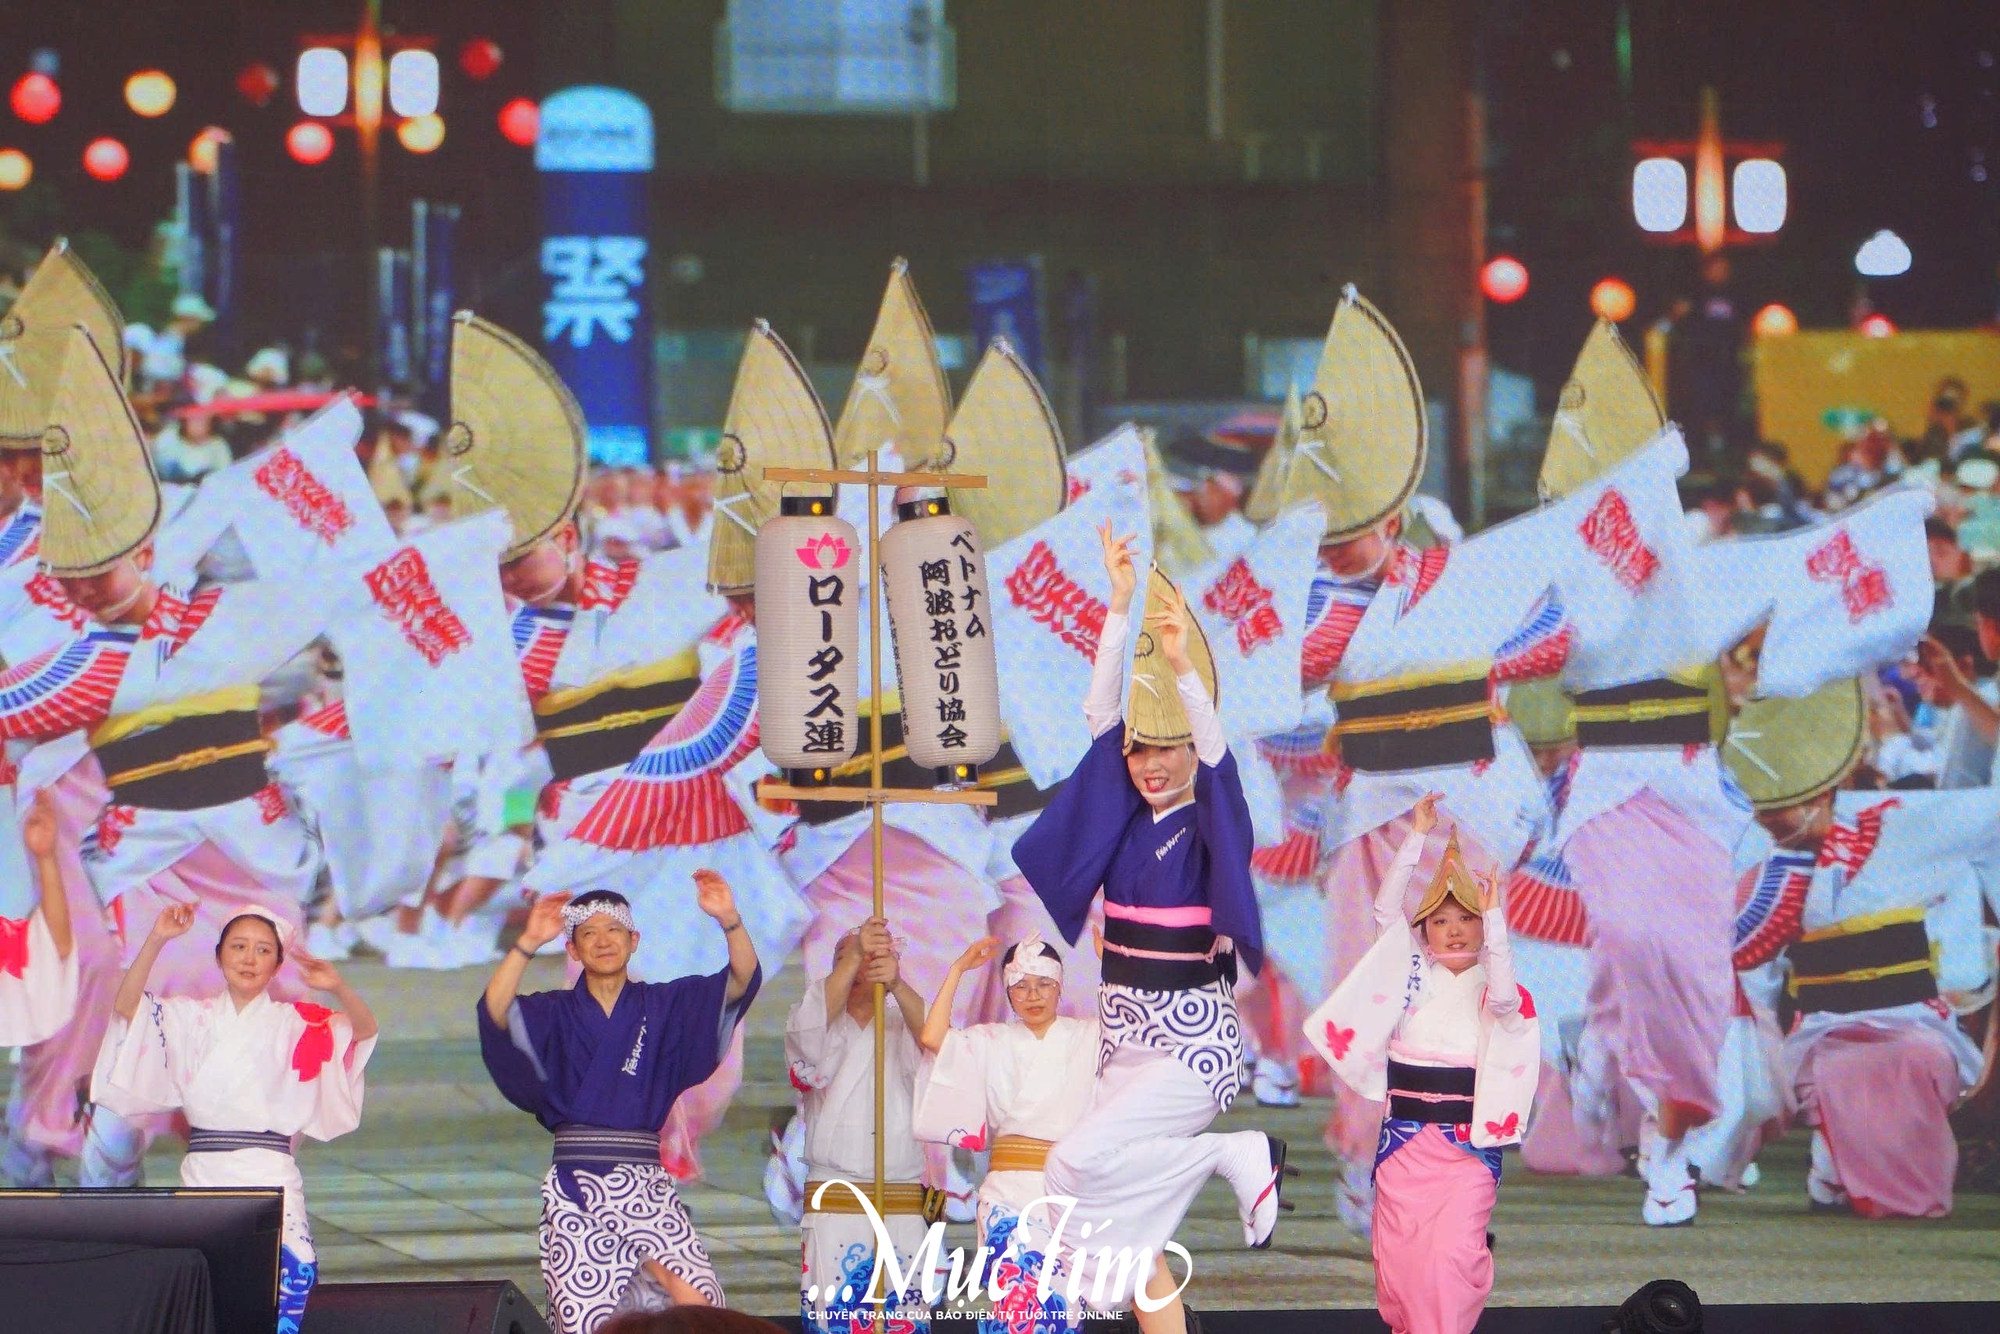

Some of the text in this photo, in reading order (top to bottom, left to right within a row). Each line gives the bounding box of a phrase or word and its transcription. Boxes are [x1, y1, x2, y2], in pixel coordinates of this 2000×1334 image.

[541, 235, 649, 347] 祭
[918, 557, 969, 750] 阿波おどり協会
[949, 529, 987, 639] ベトナム
[802, 574, 845, 753] ロータス連
